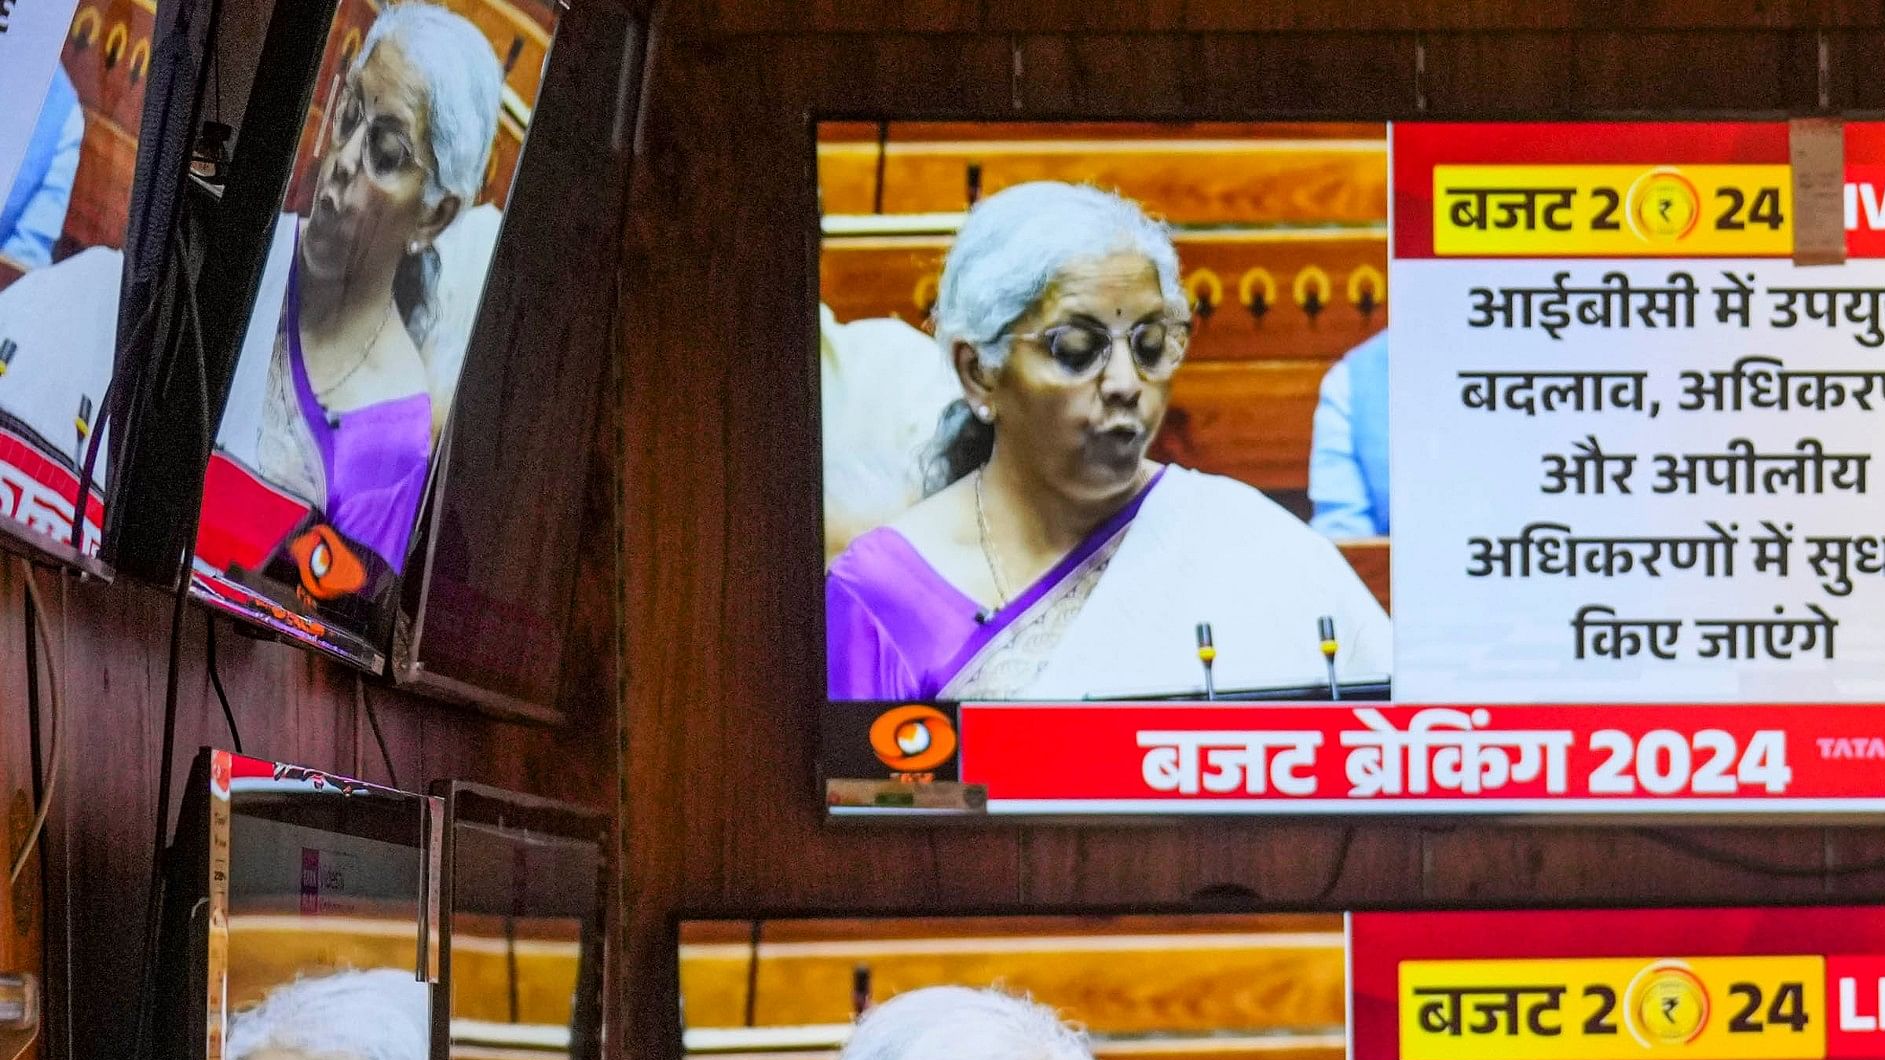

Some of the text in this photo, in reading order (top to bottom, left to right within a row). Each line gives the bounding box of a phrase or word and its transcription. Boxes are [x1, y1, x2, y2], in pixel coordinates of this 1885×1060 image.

[1445, 187, 1578, 232] बजट
[1468, 271, 1700, 340] आईबीसी
[1711, 272, 1755, 328] में
[1457, 371, 1660, 419] बदलाव,
[1541, 435, 1872, 495] और अपीलीय
[1467, 521, 1739, 577] अधिकरणों
[1750, 521, 1794, 578] में
[1570, 603, 1840, 660] किए जाएंगे
[1135, 701, 1793, 798] बजट ब्रेकिंग 2024
[1413, 985, 1567, 1037] बजट
